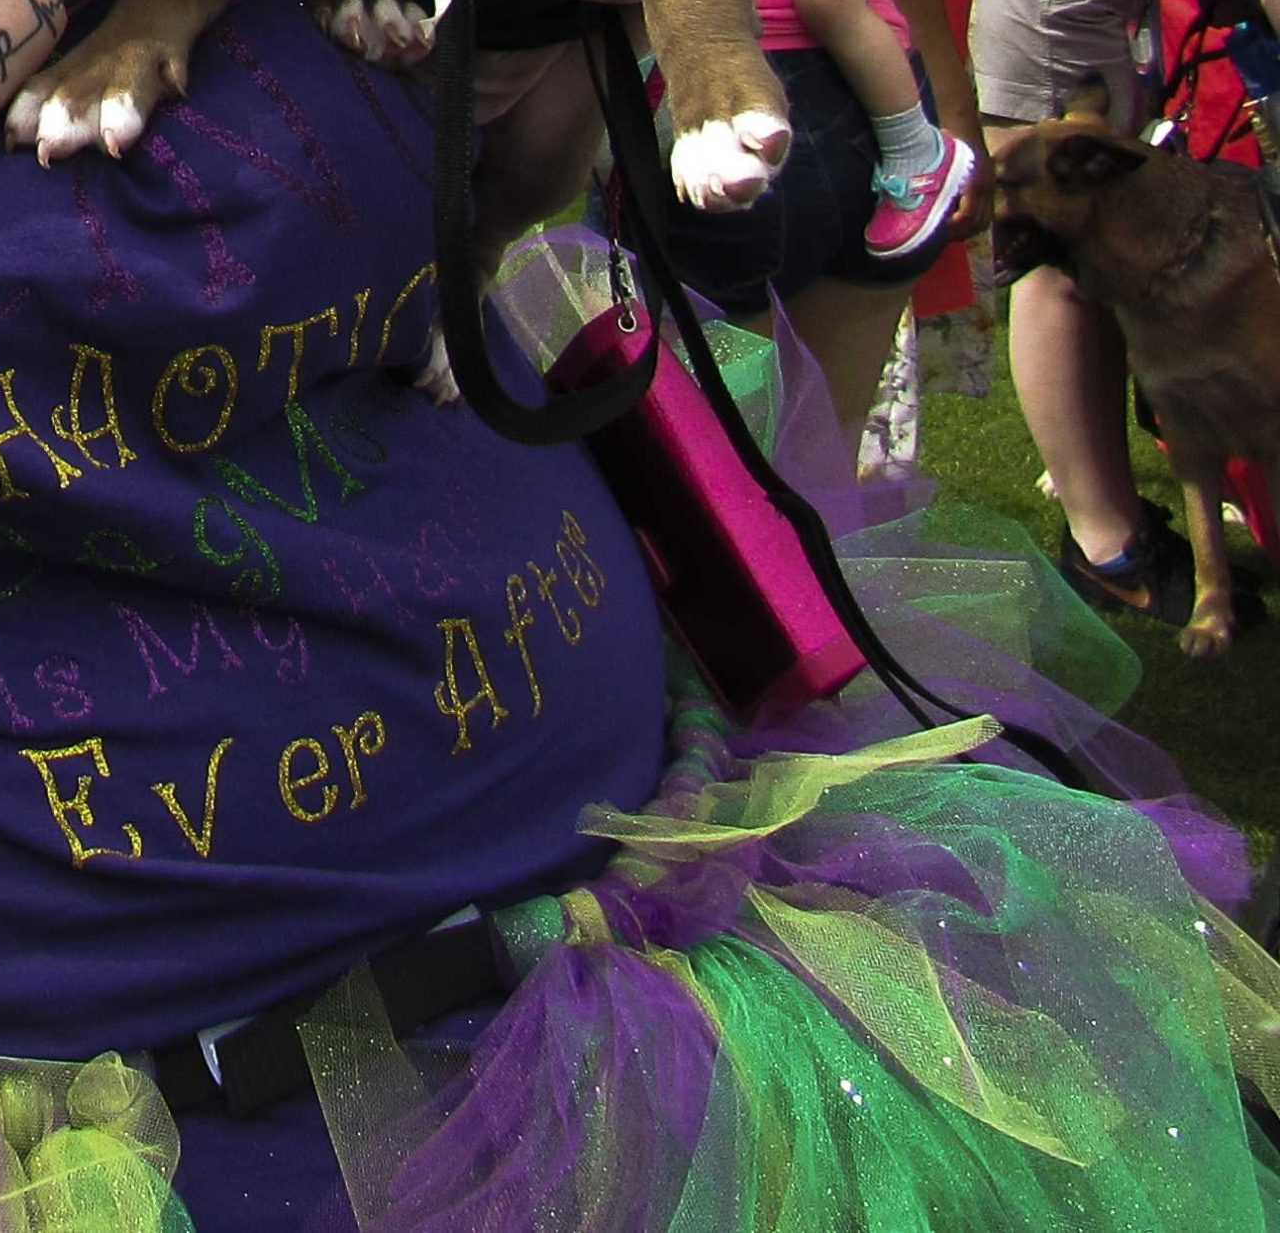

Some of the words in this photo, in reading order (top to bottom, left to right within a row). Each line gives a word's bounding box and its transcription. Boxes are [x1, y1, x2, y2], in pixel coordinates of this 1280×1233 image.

[18, 710, 388, 870] Ever
[432, 508, 607, 756] After
[110, 600, 312, 701] My
